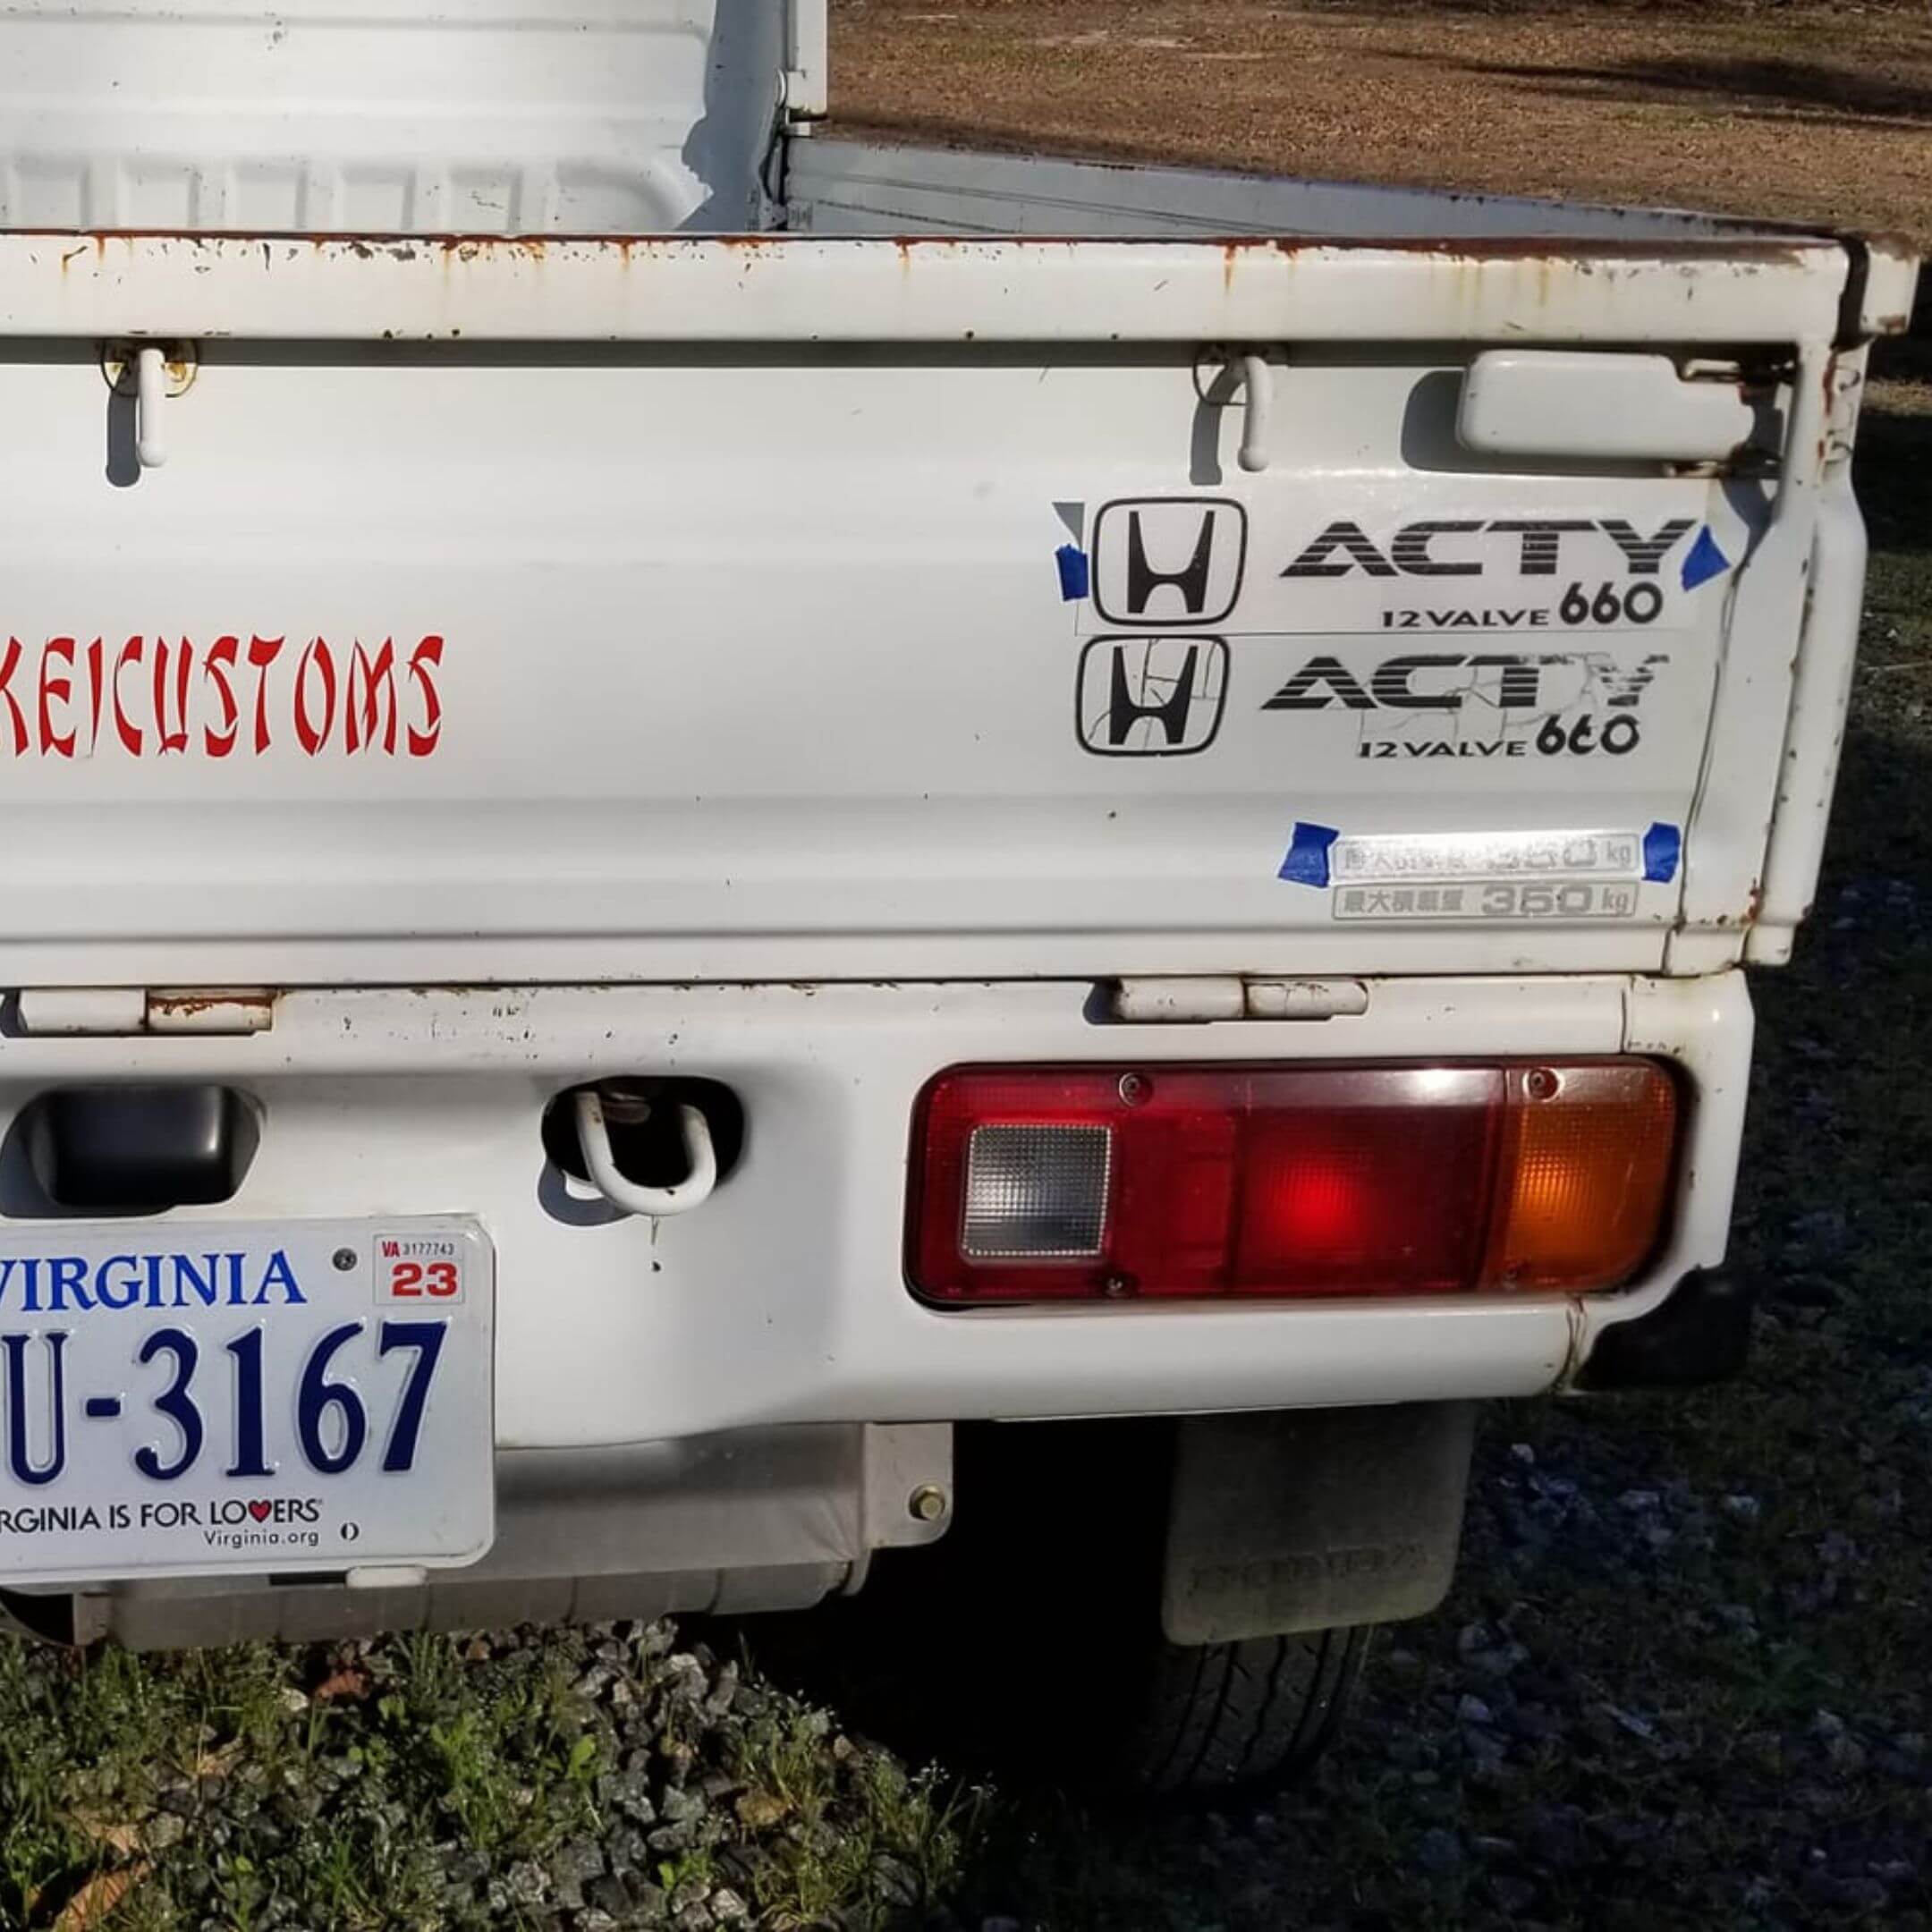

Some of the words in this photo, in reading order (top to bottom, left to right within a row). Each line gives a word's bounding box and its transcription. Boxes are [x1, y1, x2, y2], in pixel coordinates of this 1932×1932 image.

[1279, 520, 1698, 577] ACTY
[1559, 581, 1663, 625] 660
[1602, 887, 1629, 916] kg
[382, 1241, 400, 1258] VA
[392, 1262, 458, 1297] 23
[0, 1321, 447, 1486] U-3167
[109, 1504, 131, 1529] IS
[140, 1503, 201, 1527] FOR
[203, 1529, 319, 1548] Virginia.org
